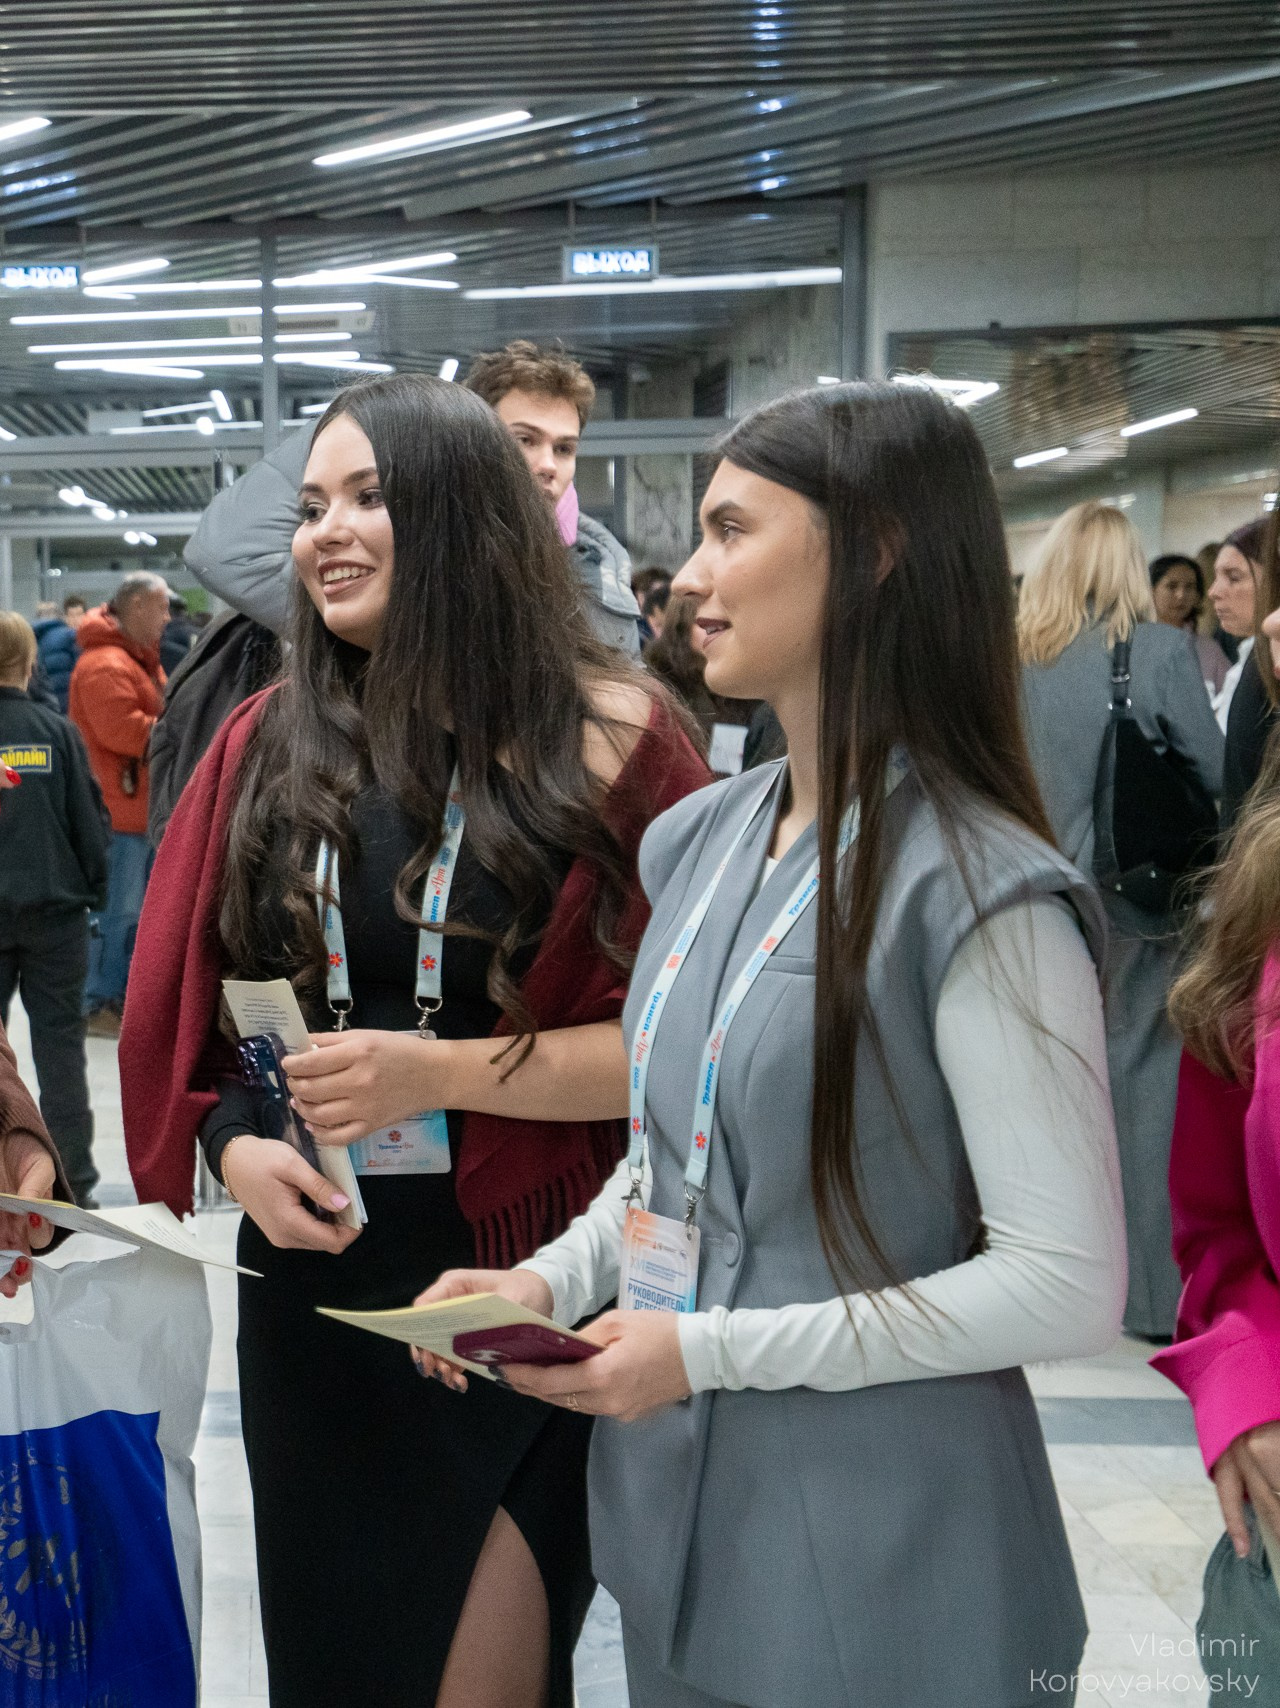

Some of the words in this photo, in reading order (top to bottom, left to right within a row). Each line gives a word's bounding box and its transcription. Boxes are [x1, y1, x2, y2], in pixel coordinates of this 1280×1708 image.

[573, 250, 650, 273] ВЫХОД
[3, 266, 78, 288] ВЫХОД
[628, 1282, 686, 1313] РУКОВОДИТЕЛЬ
